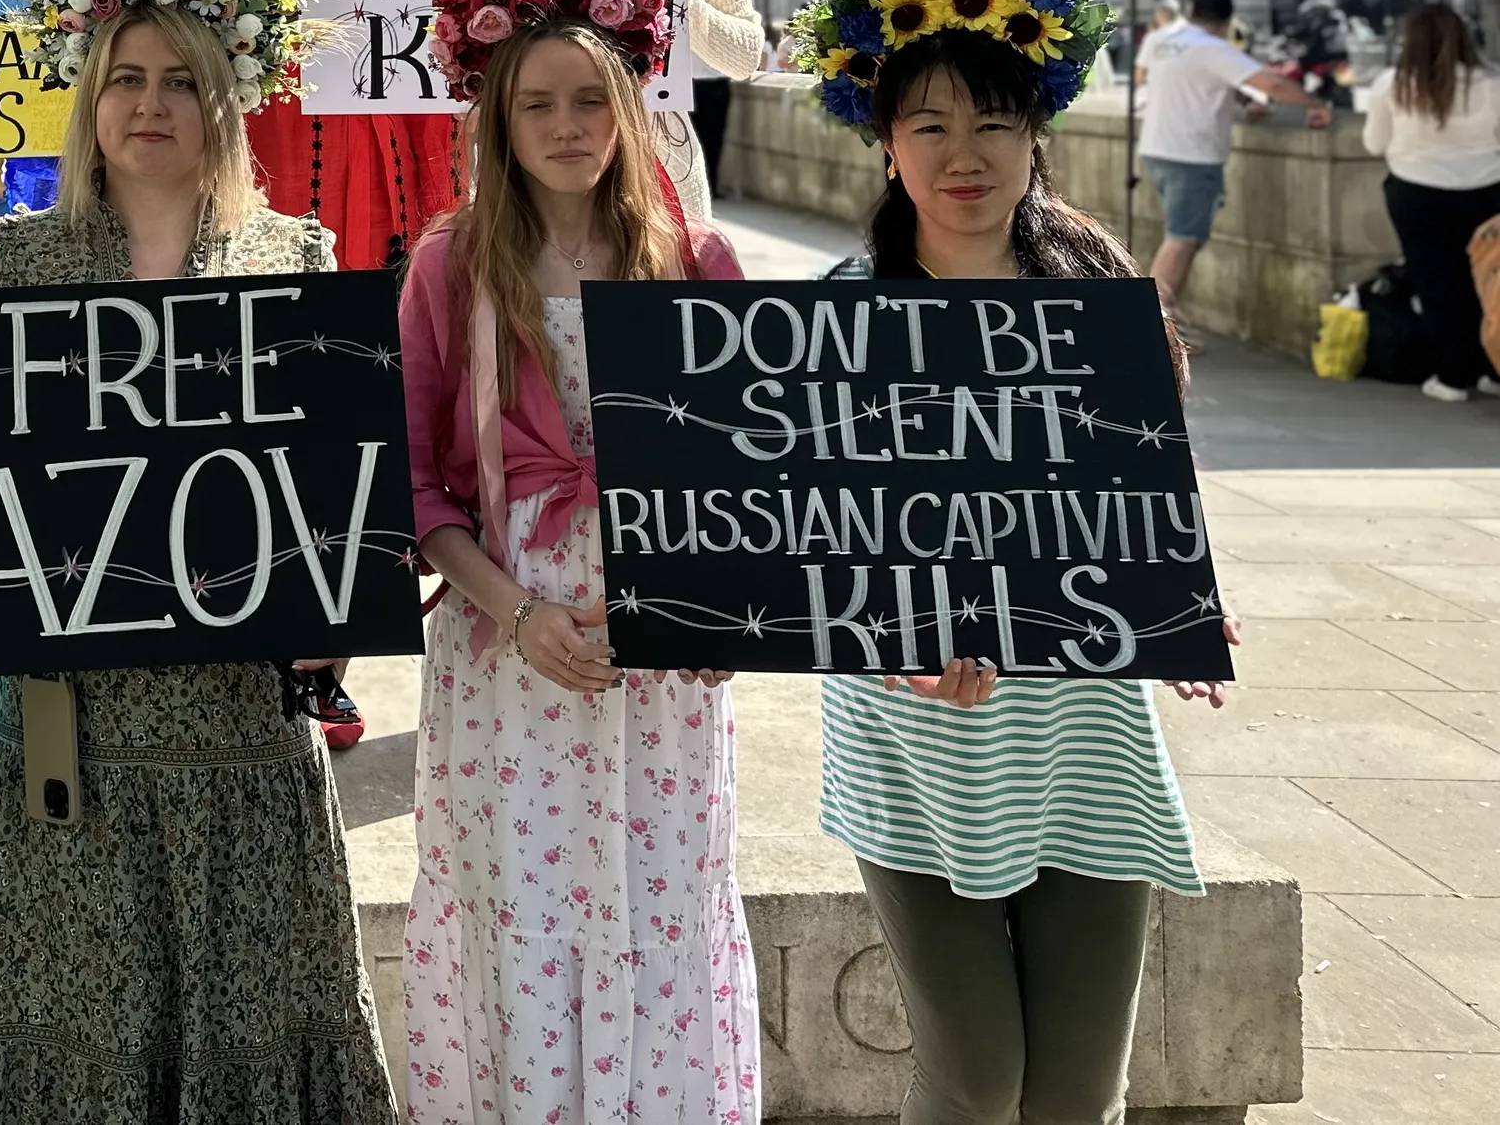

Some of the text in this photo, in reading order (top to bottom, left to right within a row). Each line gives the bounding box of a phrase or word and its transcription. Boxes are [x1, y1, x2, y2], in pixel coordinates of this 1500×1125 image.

[1, 287, 305, 435] FREE
[672, 295, 1095, 376] DON'T BE
[730, 380, 1083, 463] SILENT
[800, 565, 1137, 672] KILLS
